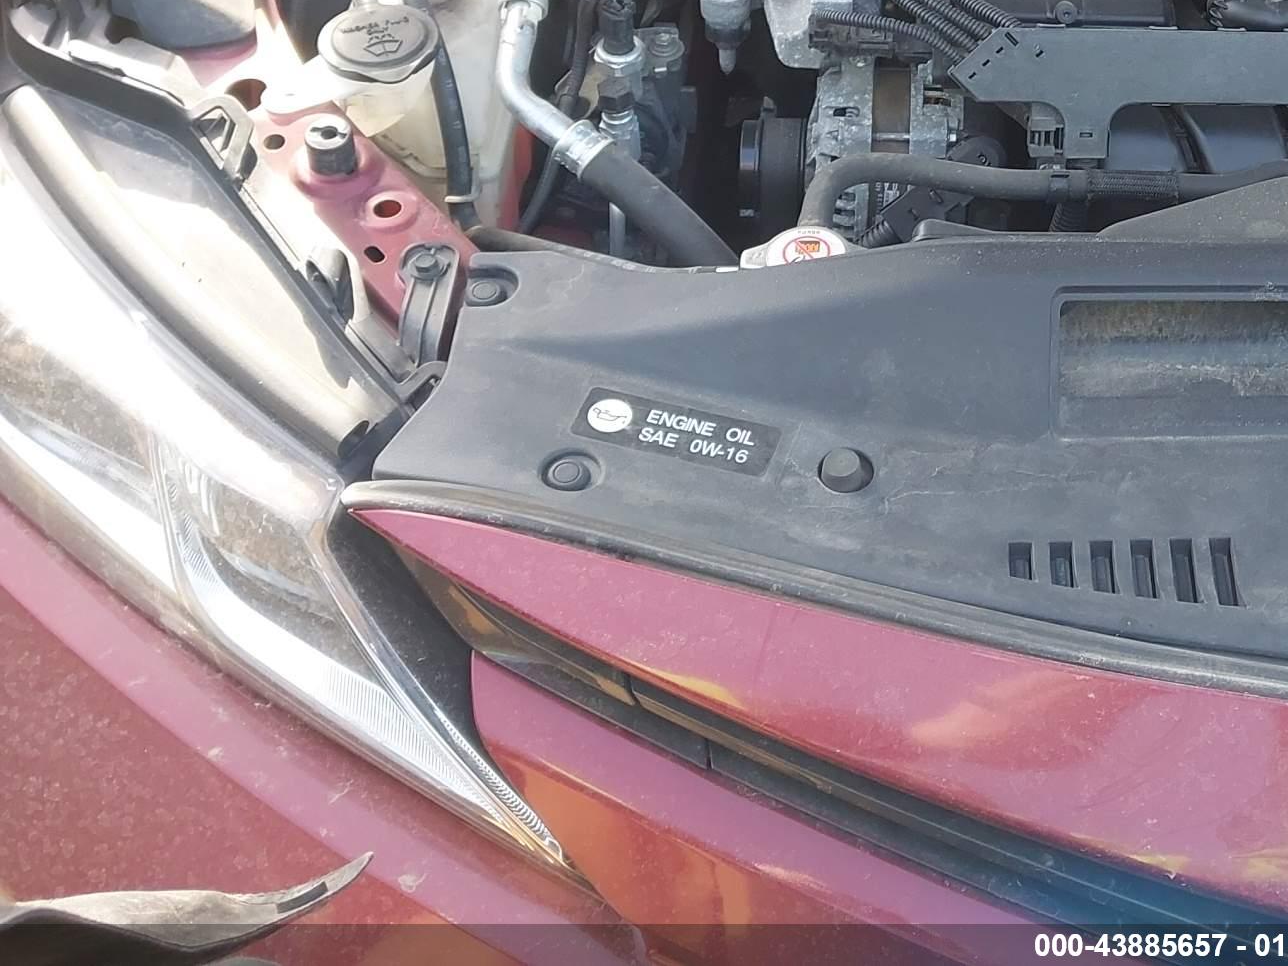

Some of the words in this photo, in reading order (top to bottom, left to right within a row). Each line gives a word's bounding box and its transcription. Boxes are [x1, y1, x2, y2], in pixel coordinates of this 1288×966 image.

[638, 426, 680, 448] SAE
[689, 438, 750, 465] 0W-16
[645, 408, 717, 438] ENGINE
[725, 426, 756, 447] OIL
